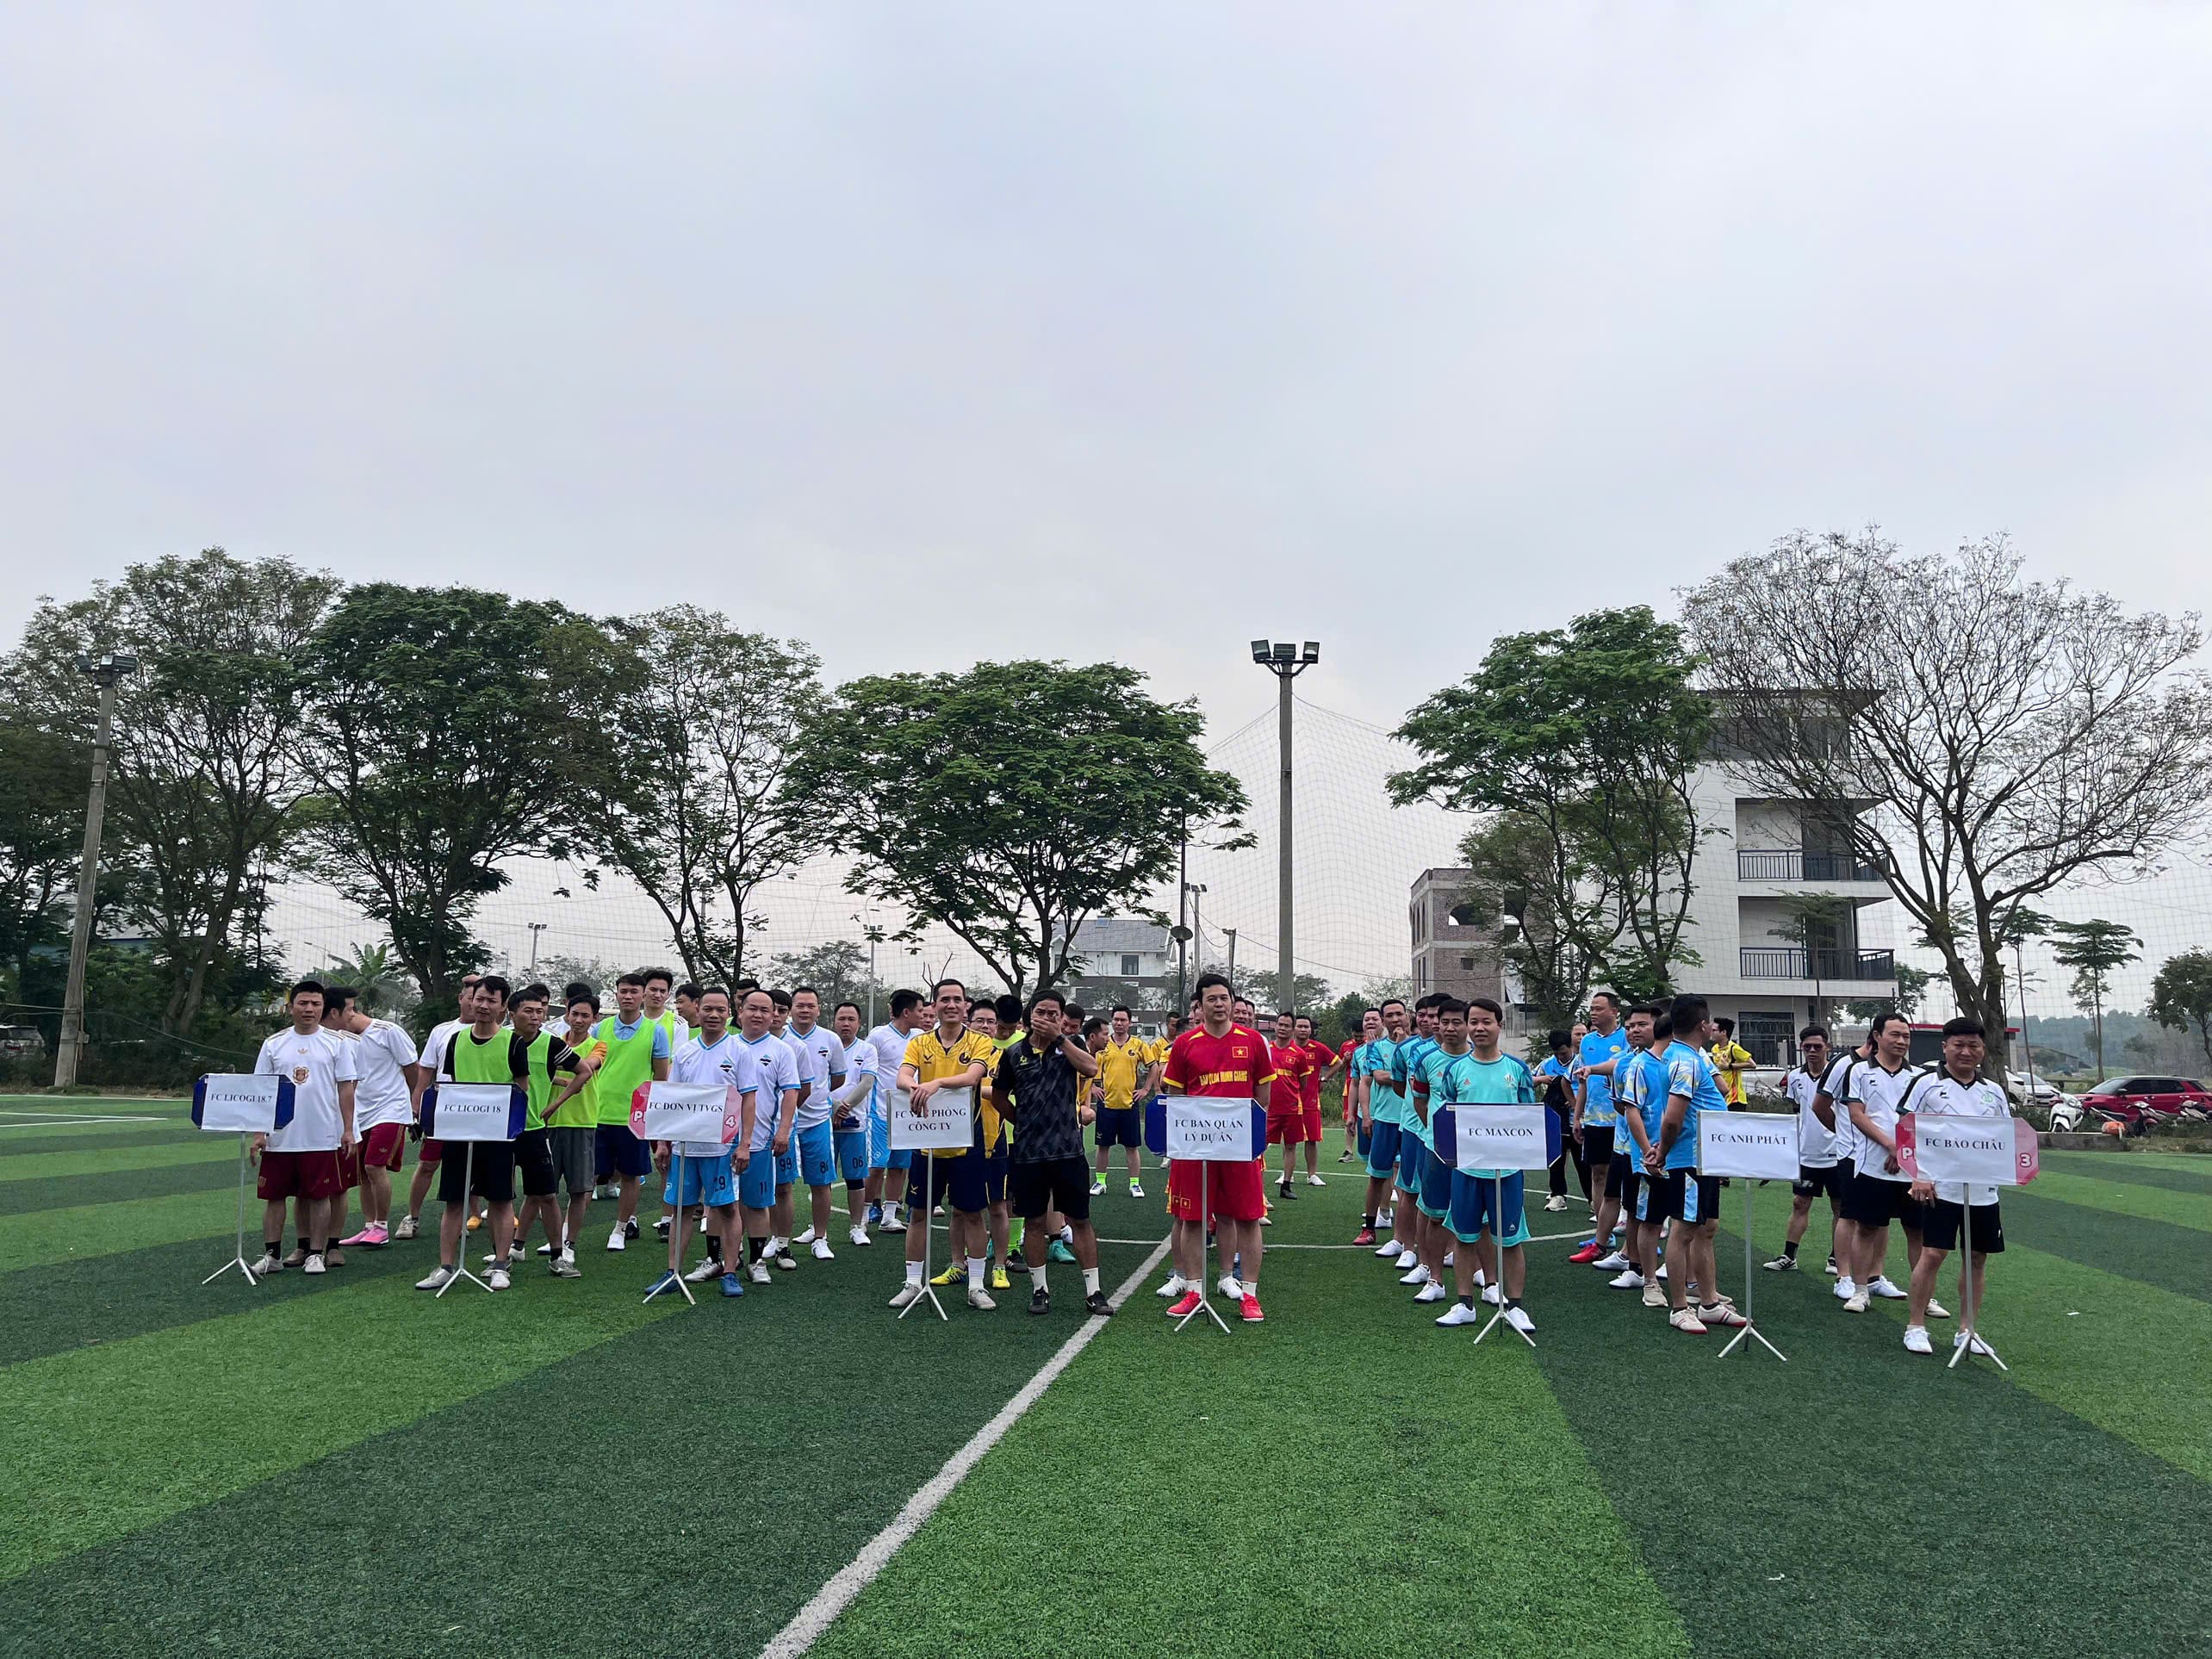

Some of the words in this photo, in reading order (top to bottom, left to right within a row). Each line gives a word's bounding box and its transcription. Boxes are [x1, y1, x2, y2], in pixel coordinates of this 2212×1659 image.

[224, 1094, 255, 1103] LICOGI
[444, 1104, 455, 1113] FC
[458, 1104, 489, 1113] LICOGI
[663, 1101, 684, 1110] ĐƠN
[687, 1103, 696, 1113] VỊ
[699, 1104, 723, 1113] TVGS
[724, 1115, 736, 1128] 4
[908, 1122, 936, 1131] CÔNG
[1190, 1120, 1211, 1128] BAN
[1184, 1132, 1197, 1141] LÝ
[1201, 1133, 1216, 1143] DỰ
[1485, 1128, 1533, 1137] MAXCON
[1711, 1134, 1725, 1142] FC
[1729, 1134, 1753, 1144] ANH
[1757, 1134, 1787, 1145] PHÁT
[1925, 1138, 1942, 1147] FC
[1973, 1139, 2005, 1151] CHÂU
[779, 1158, 792, 1171] 99
[2019, 1153, 2033, 1167] 3
[760, 1181, 767, 1195] 11
